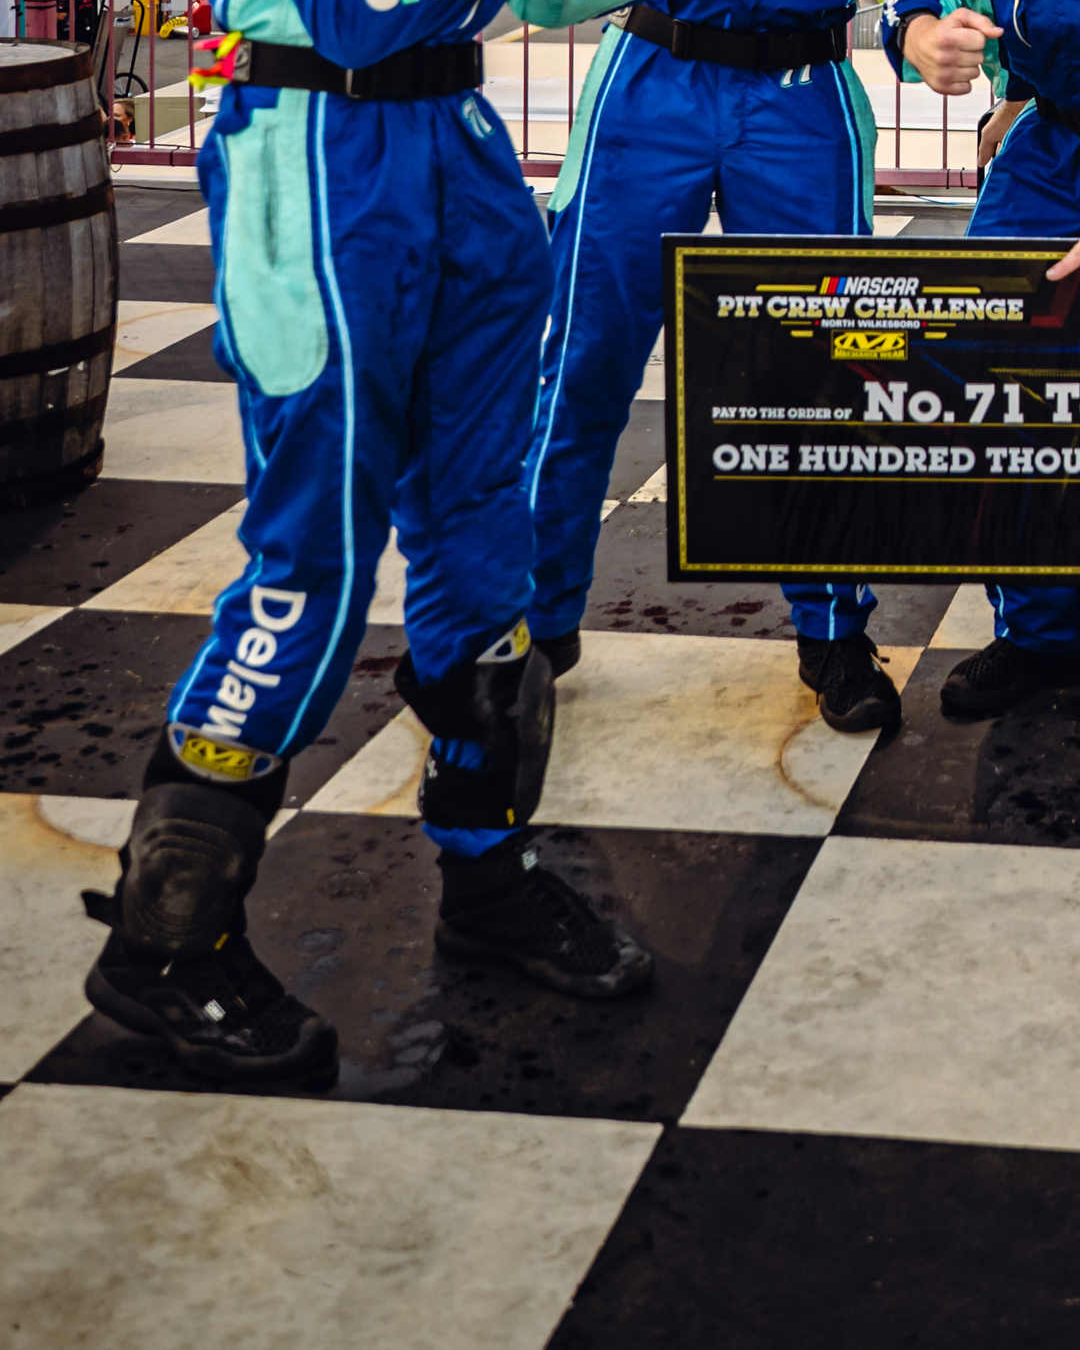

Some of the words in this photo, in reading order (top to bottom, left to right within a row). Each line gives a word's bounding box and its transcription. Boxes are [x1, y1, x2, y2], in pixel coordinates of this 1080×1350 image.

[843, 277, 919, 296] NASCAR
[717, 295, 761, 317] PIT
[766, 297, 850, 318] CREW
[854, 297, 1024, 320] CHALLENGE
[820, 318, 855, 329] NORTH
[857, 319, 920, 330] WILKESBORO
[833, 348, 877, 359] MECHANIX
[879, 349, 905, 359] WEAR
[712, 407, 737, 419] PAY
[739, 407, 757, 419] TO
[760, 407, 785, 419] THE
[788, 407, 832, 420] ORDER
[833, 408, 852, 420] OF
[863, 381, 955, 424] No.
[965, 383, 1024, 424] 71
[712, 443, 790, 472] ONE
[799, 445, 976, 473] HUNDRED
[201, 585, 306, 739] Delaw
